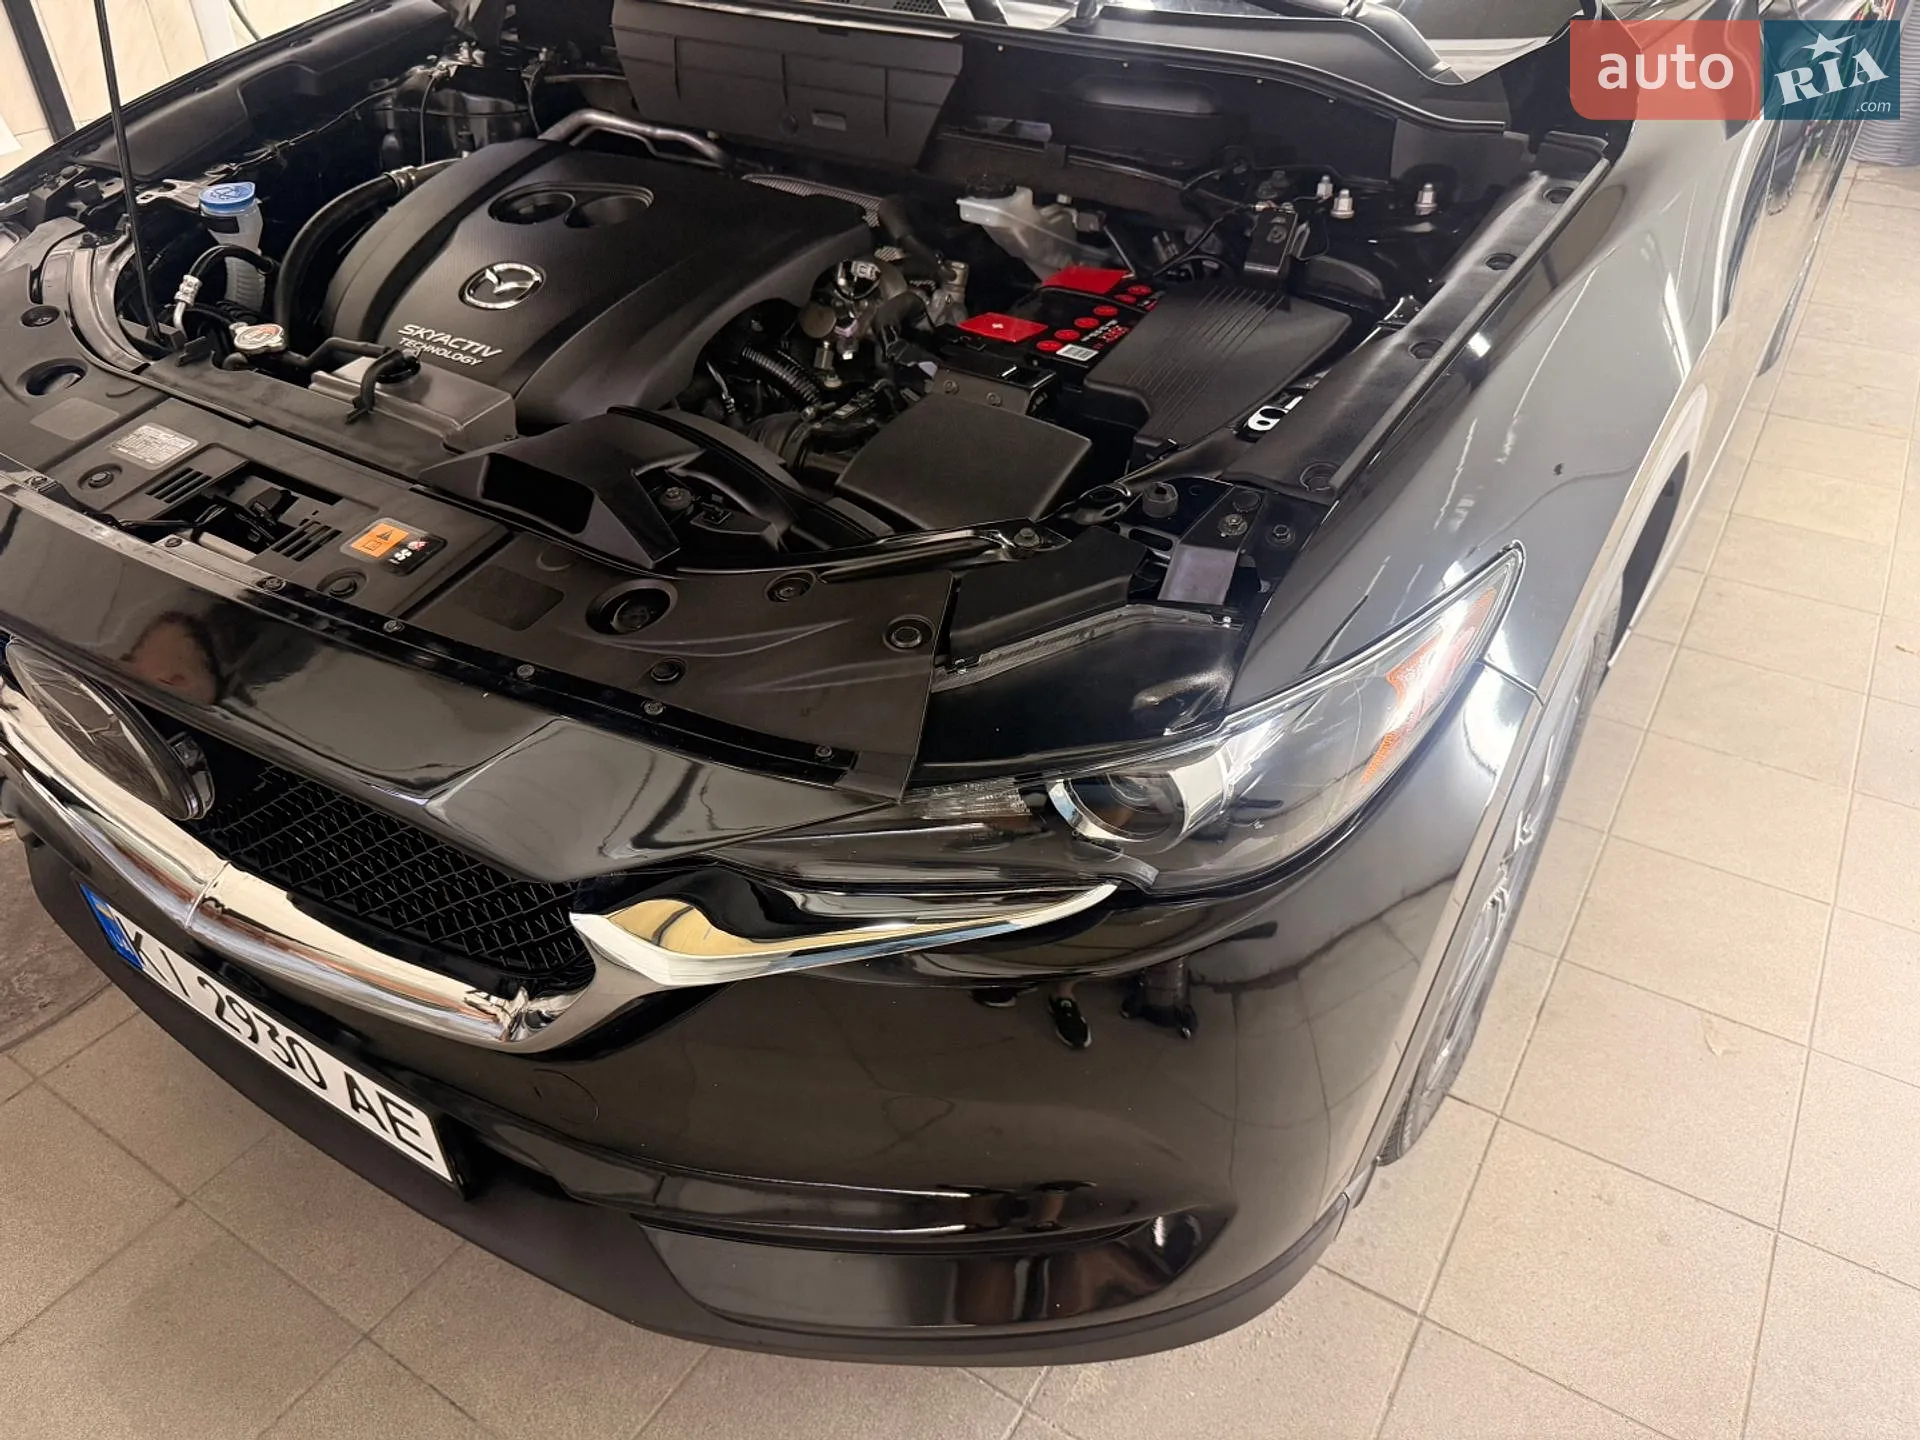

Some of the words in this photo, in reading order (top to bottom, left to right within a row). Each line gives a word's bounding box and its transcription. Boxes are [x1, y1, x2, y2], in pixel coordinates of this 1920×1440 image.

[398, 324, 503, 358] SKYACTIV
[399, 337, 484, 366] TECHNOLOGY
[197, 976, 328, 1091] 2930
[344, 1071, 434, 1162] AE
